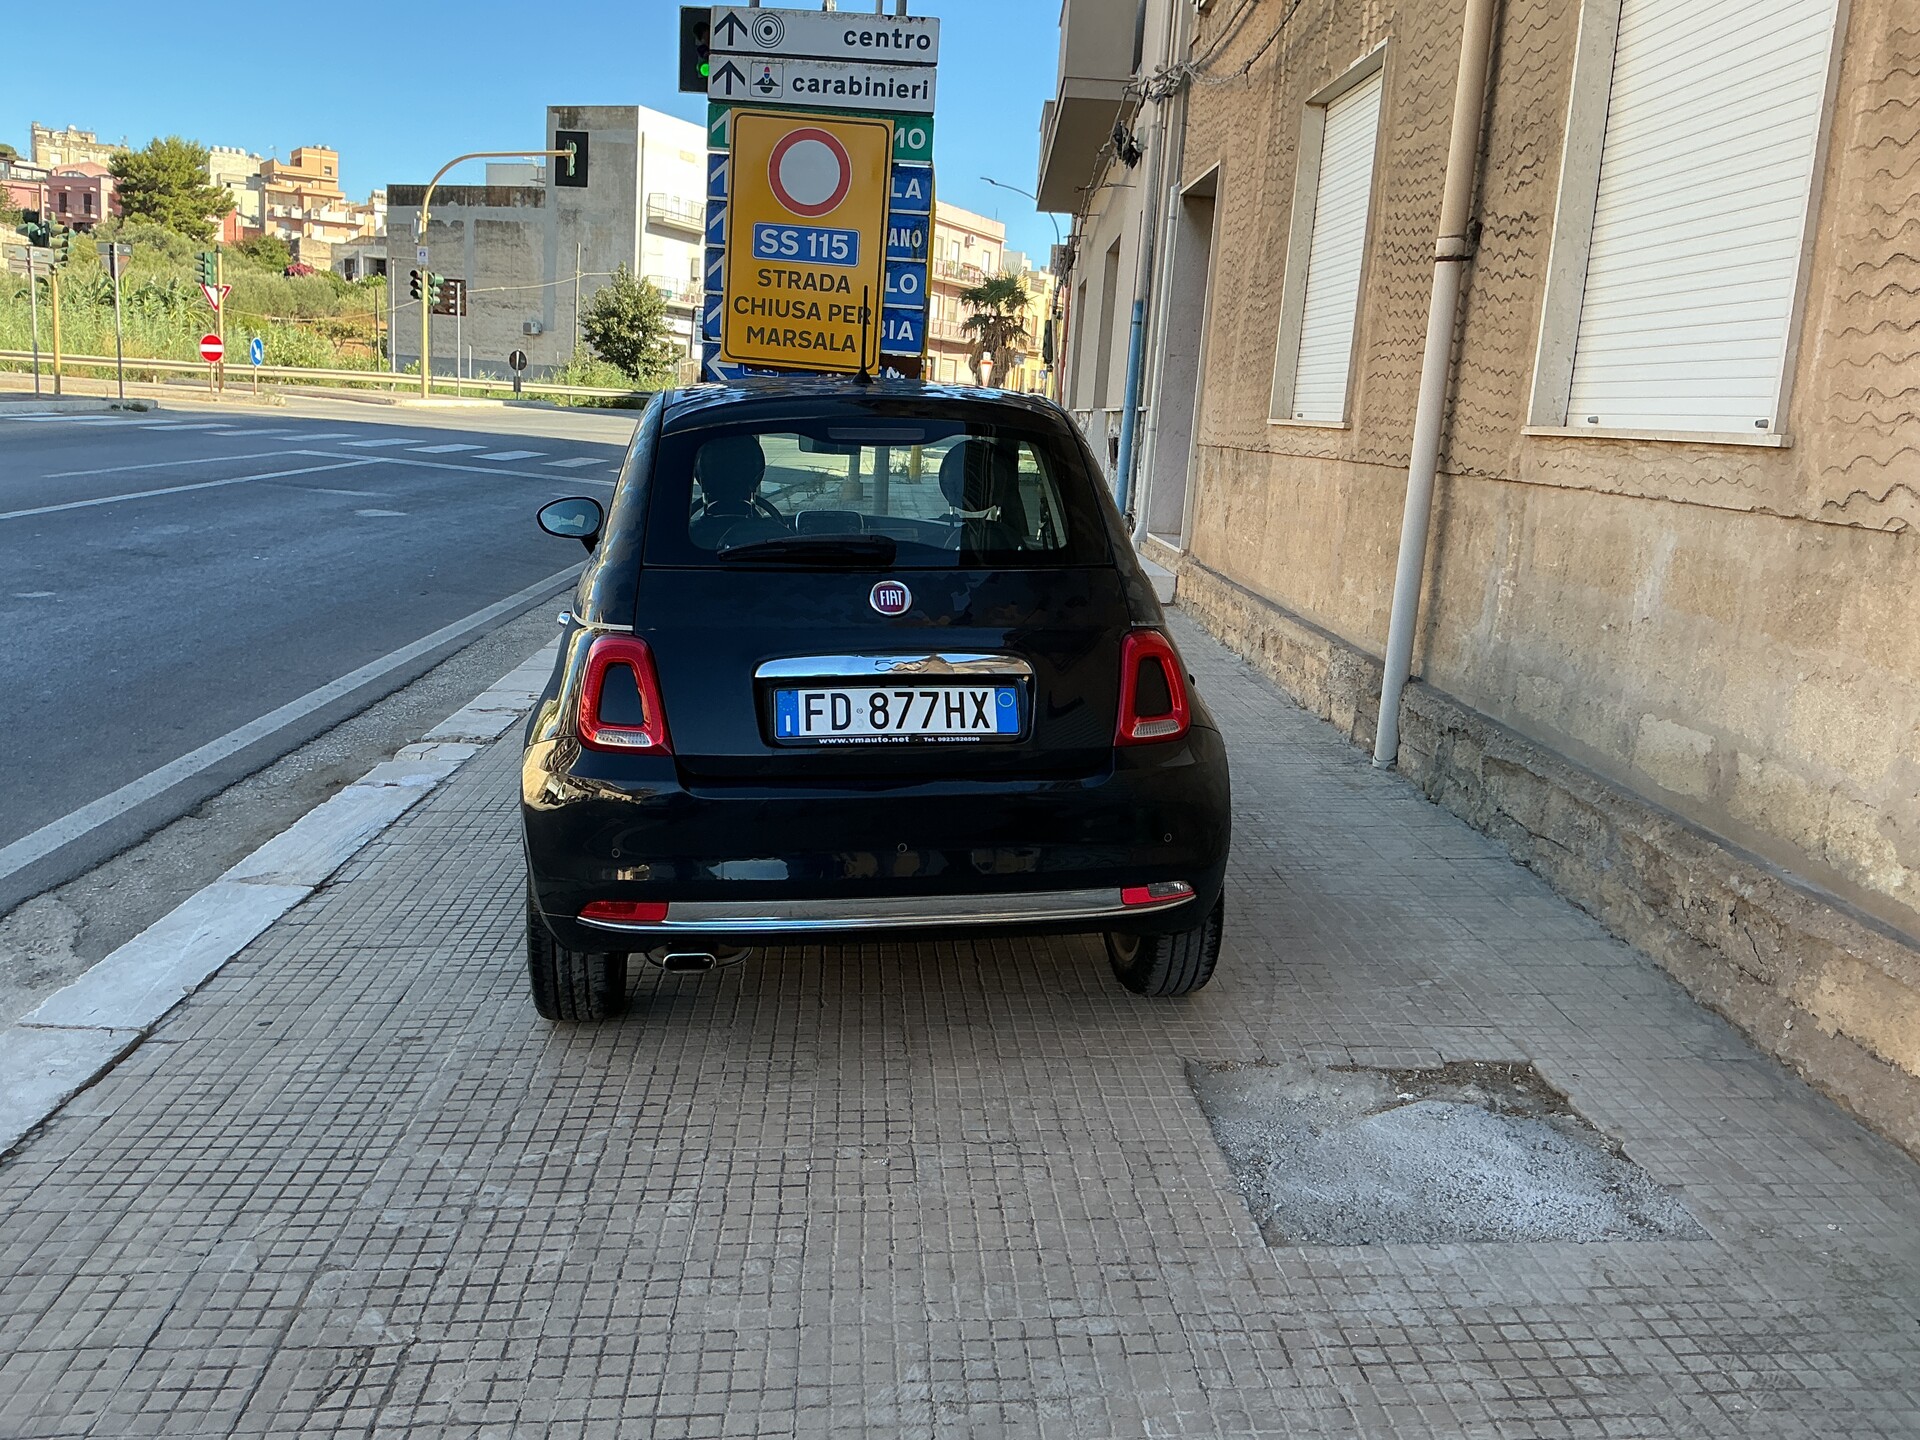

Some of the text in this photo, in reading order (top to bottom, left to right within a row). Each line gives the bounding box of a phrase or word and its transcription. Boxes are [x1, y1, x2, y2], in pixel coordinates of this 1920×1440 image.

[843, 28, 931, 50] centro
[792, 74, 929, 100] carabinieri
[760, 228, 849, 260] SS 115
[757, 268, 851, 294] STRADA
[733, 295, 872, 325] CHIUSA PER
[746, 325, 857, 353] MARSALA
[879, 589, 903, 606] FIAT
[804, 691, 991, 732] FD 877HX
[818, 736, 910, 745] www.vmauto.net
